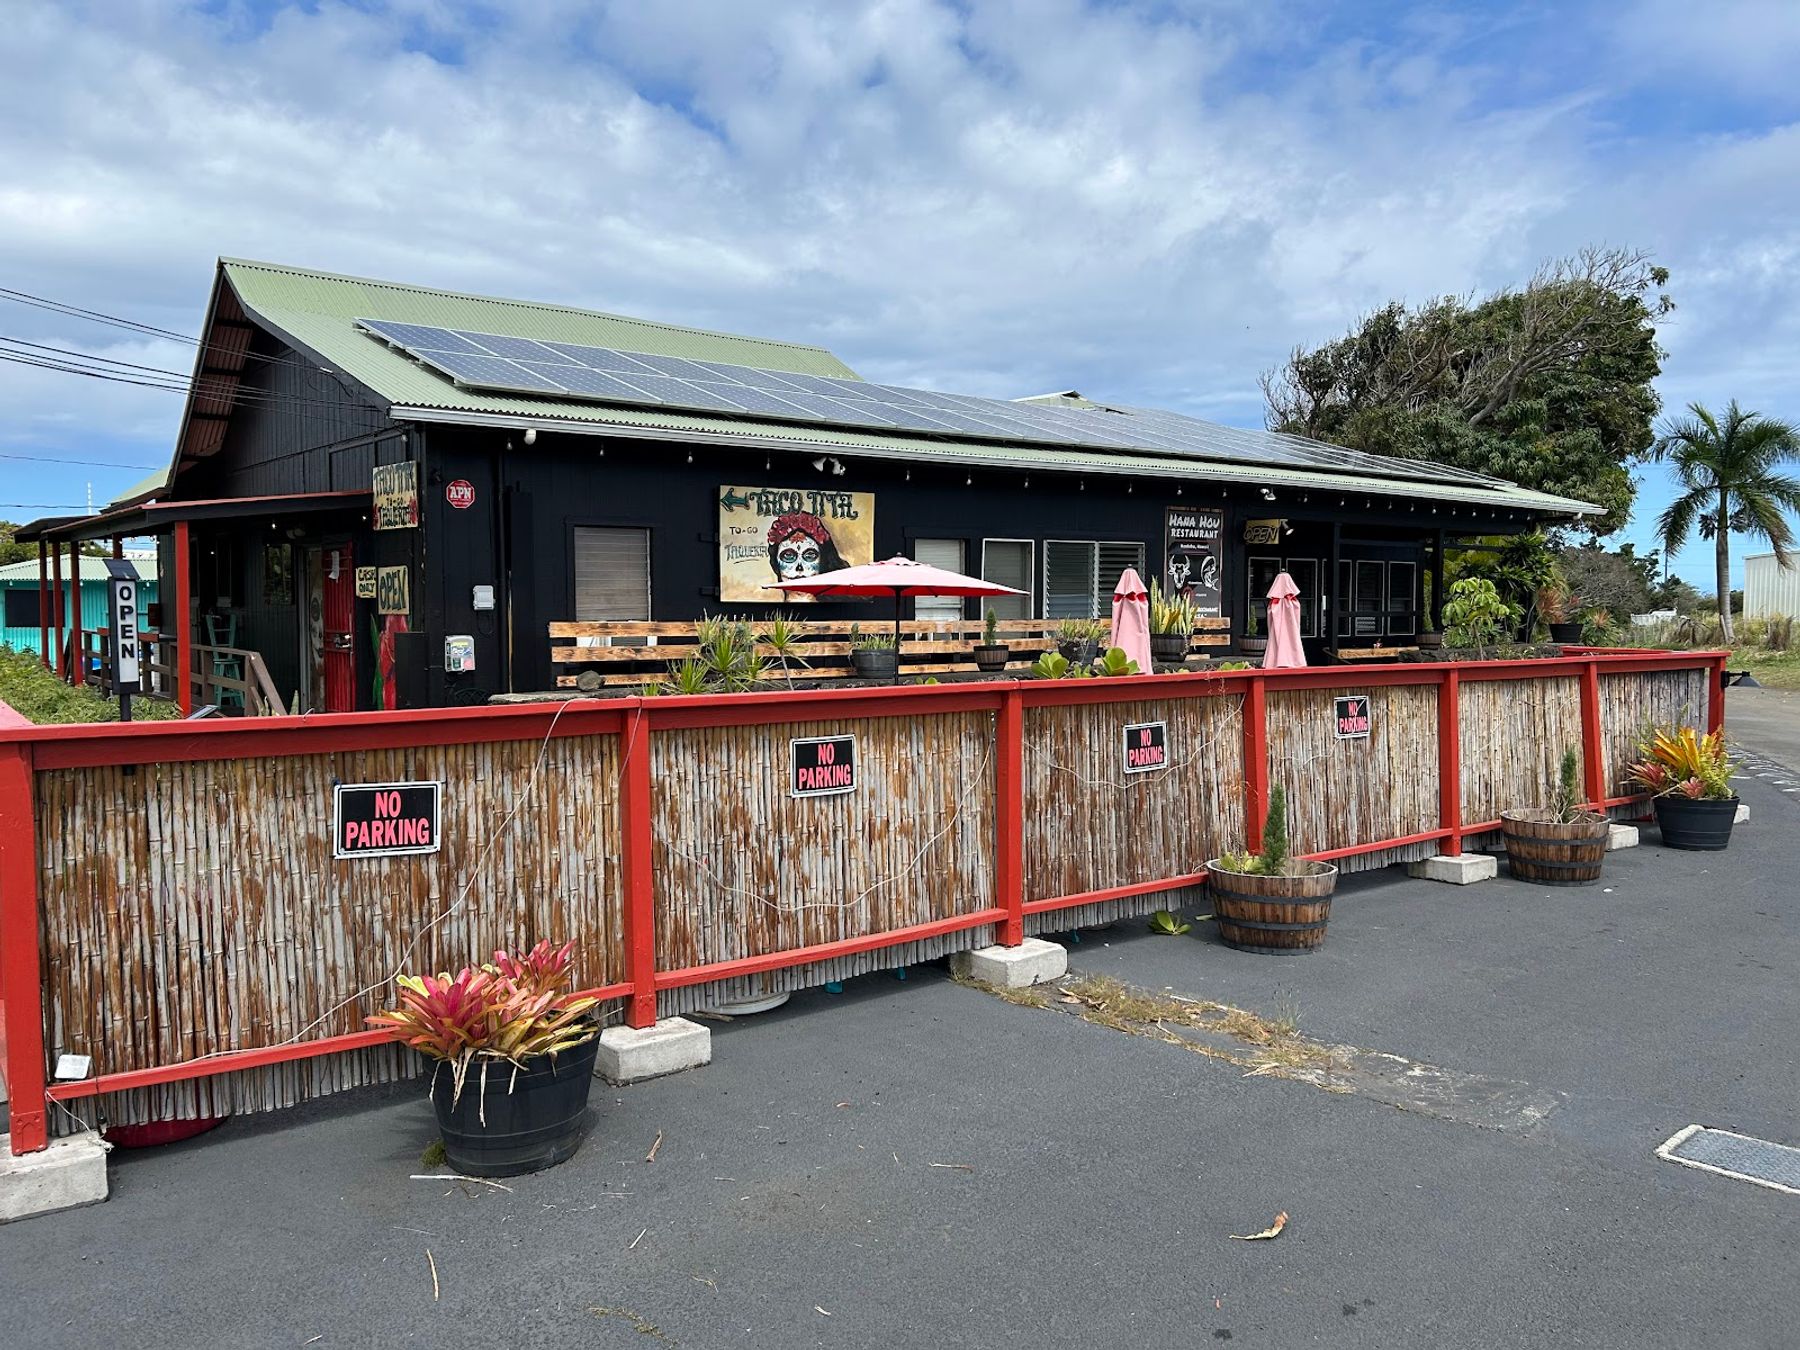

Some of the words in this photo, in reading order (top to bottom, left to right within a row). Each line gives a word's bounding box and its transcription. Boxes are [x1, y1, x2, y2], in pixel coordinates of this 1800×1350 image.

[450, 486, 471, 499] APN
[749, 488, 803, 517] TACO
[729, 526, 758, 535] TO-GO
[1169, 513, 1195, 528] HANA
[1199, 515, 1220, 529] HOU
[1171, 528, 1218, 539] RESTAURANT
[1243, 526, 1279, 543] OPEN
[380, 567, 407, 610] OPEN
[119, 585, 135, 659] OPEN
[1348, 701, 1358, 716] NO
[1339, 716, 1367, 733] PARKING
[1140, 728, 1152, 747] NO
[818, 743, 835, 765] NO
[1128, 745, 1164, 767] PARKING
[799, 764, 852, 790] PARKING
[375, 791, 401, 819] NO
[345, 818, 430, 849] PARKING
